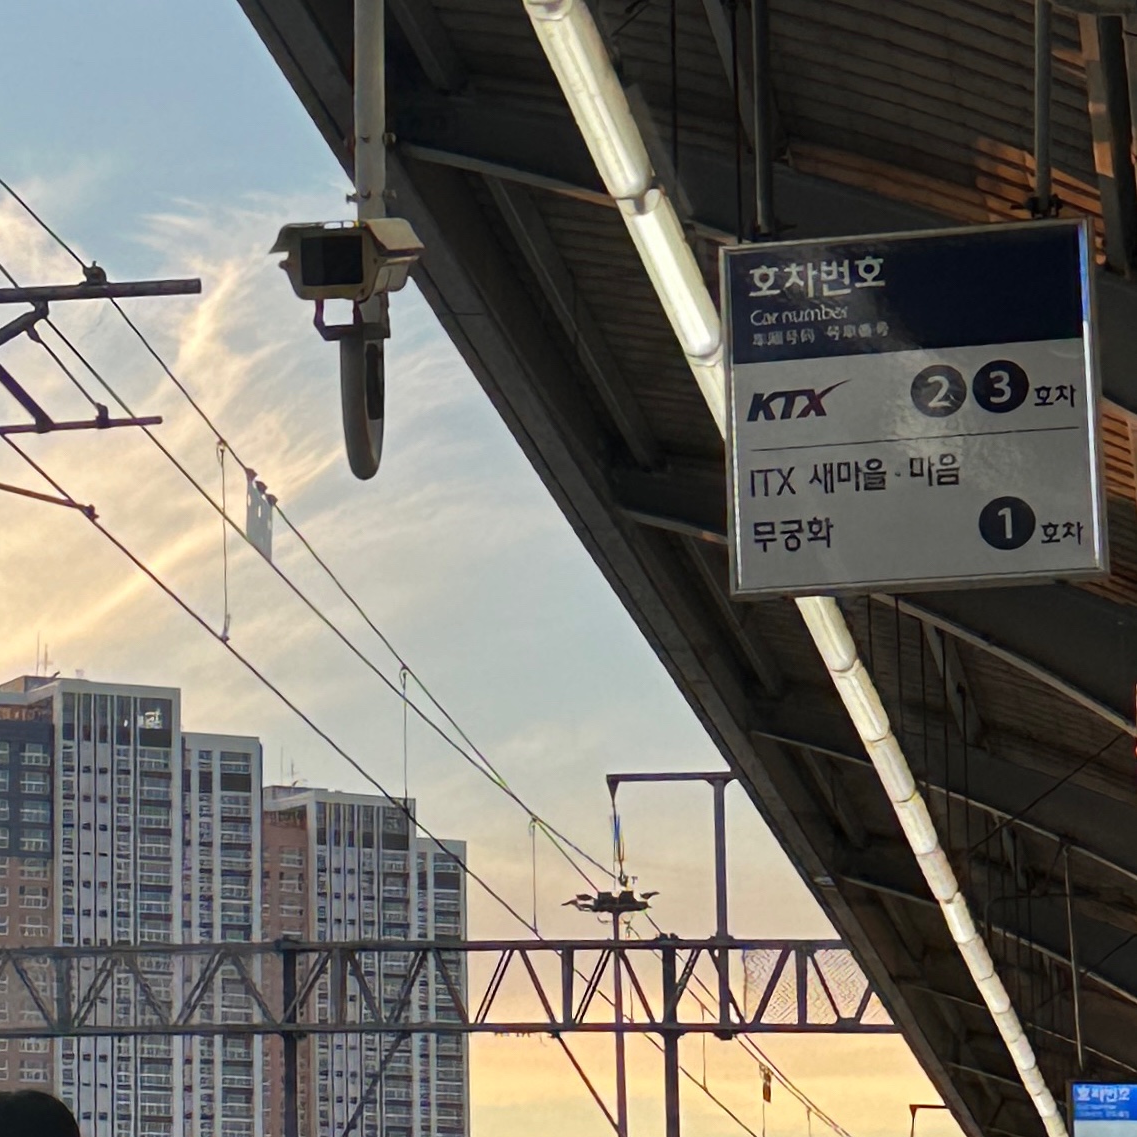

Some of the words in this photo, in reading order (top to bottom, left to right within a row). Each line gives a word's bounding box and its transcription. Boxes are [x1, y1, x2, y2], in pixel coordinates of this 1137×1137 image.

[749, 255, 886, 299] 호차번호
[750, 307, 779, 327] Car
[781, 303, 849, 325] number
[746, 379, 852, 422] KTX
[749, 466, 797, 498] ITX
[753, 516, 834, 553] 무궁화
